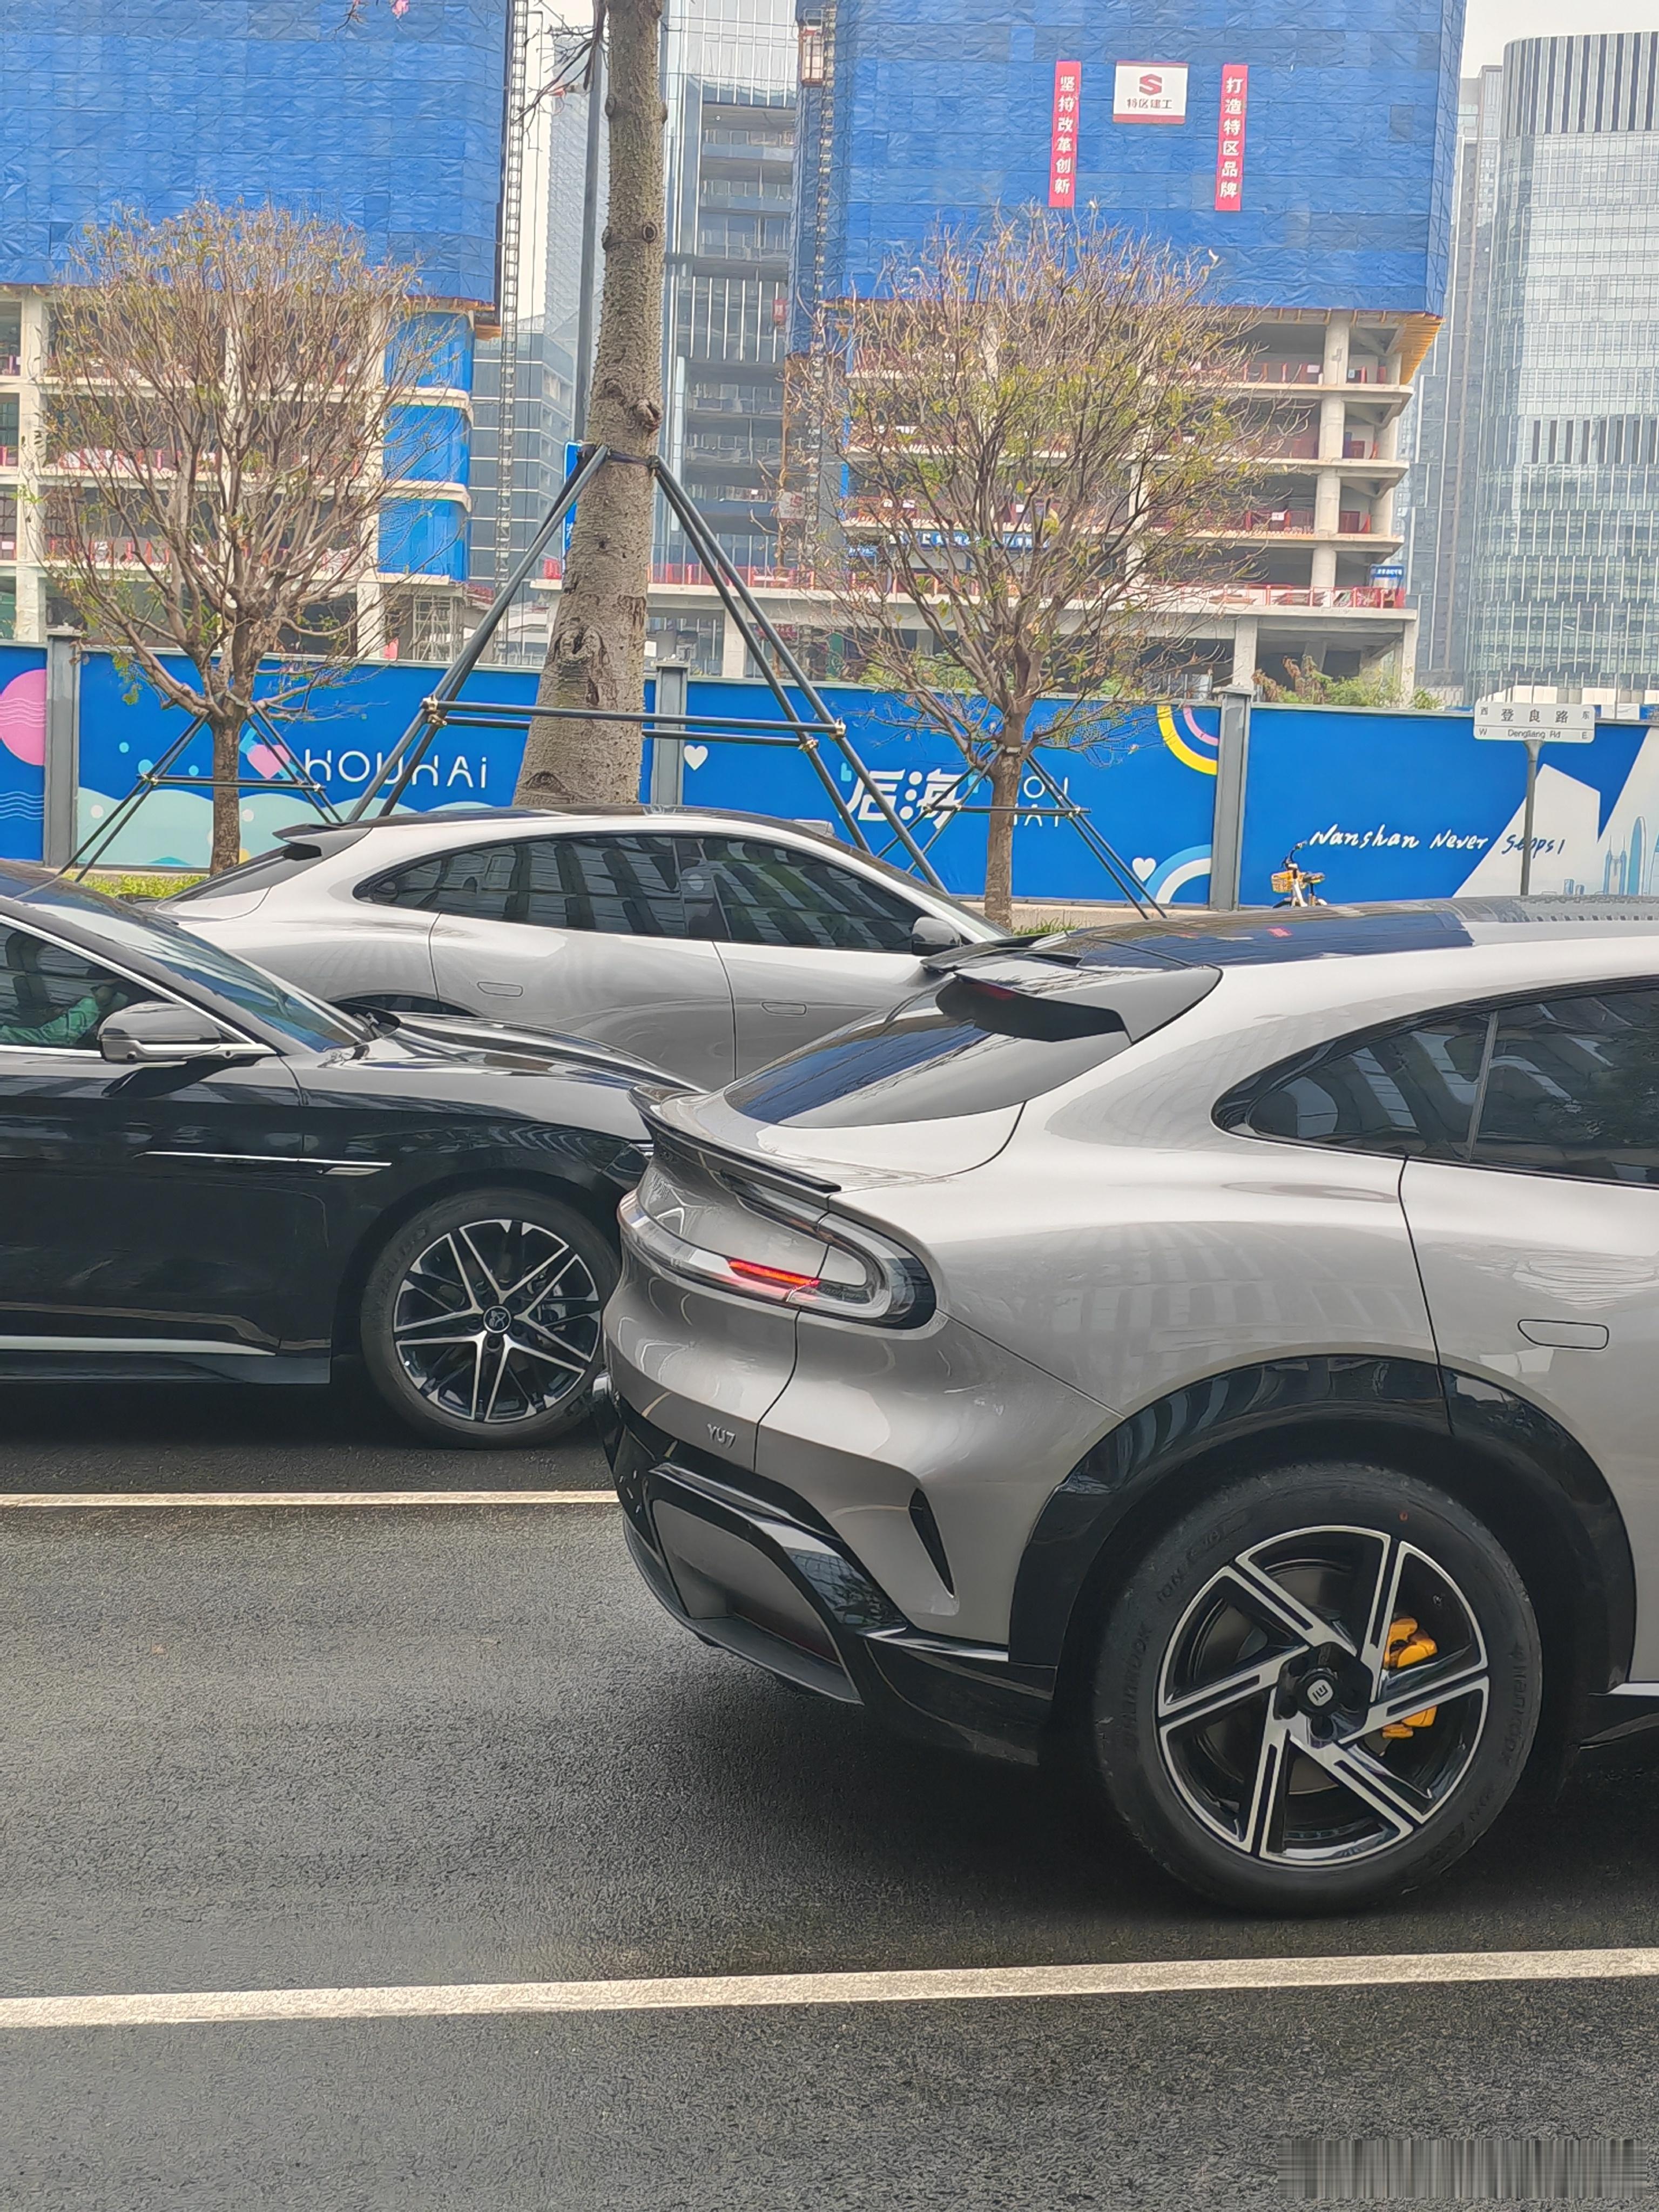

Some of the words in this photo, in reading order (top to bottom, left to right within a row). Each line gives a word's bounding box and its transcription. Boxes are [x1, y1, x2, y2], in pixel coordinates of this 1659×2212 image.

[1054, 76, 1075, 194] 坚持改革创新
[1219, 77, 1244, 198] 打造特区品牌
[1480, 706, 1488, 716] 西
[1501, 709, 1568, 724] 登良路
[1582, 711, 1589, 720] 东
[1507, 729, 1546, 739] Dengliang
[1309, 824, 1420, 849] Nanshan
[1429, 828, 1489, 849] Never
[707, 1423, 736, 1449] YU7
